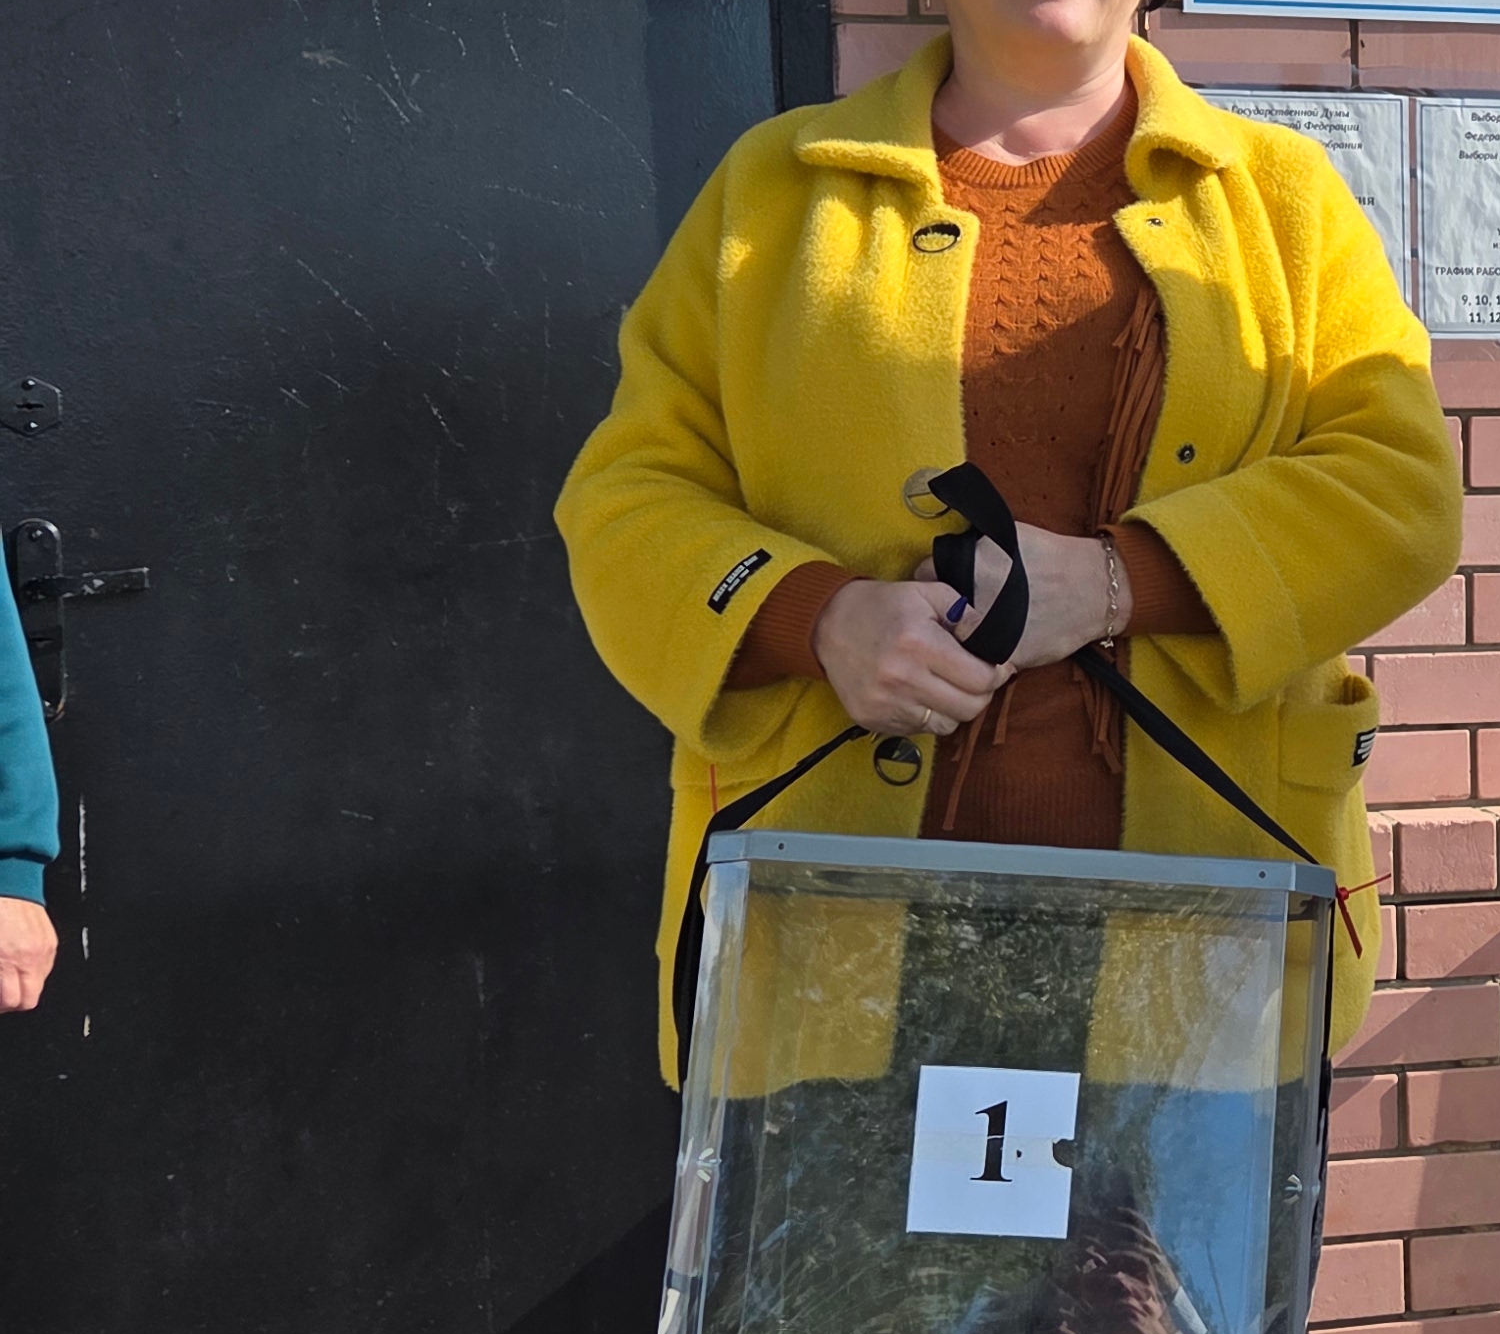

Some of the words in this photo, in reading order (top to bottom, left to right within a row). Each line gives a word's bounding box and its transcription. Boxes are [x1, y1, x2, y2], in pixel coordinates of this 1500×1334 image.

[1319, 107, 1350, 121] Думы
[1303, 120, 1360, 134] Федерации
[1458, 150, 1499, 161] Выборы
[1435, 266, 1475, 276] ГРАФИК
[1461, 294, 1472, 307] 9,
[1475, 294, 1492, 307] 10,
[1469, 312, 1486, 324] 11,
[970, 1100, 1013, 1183] 1
